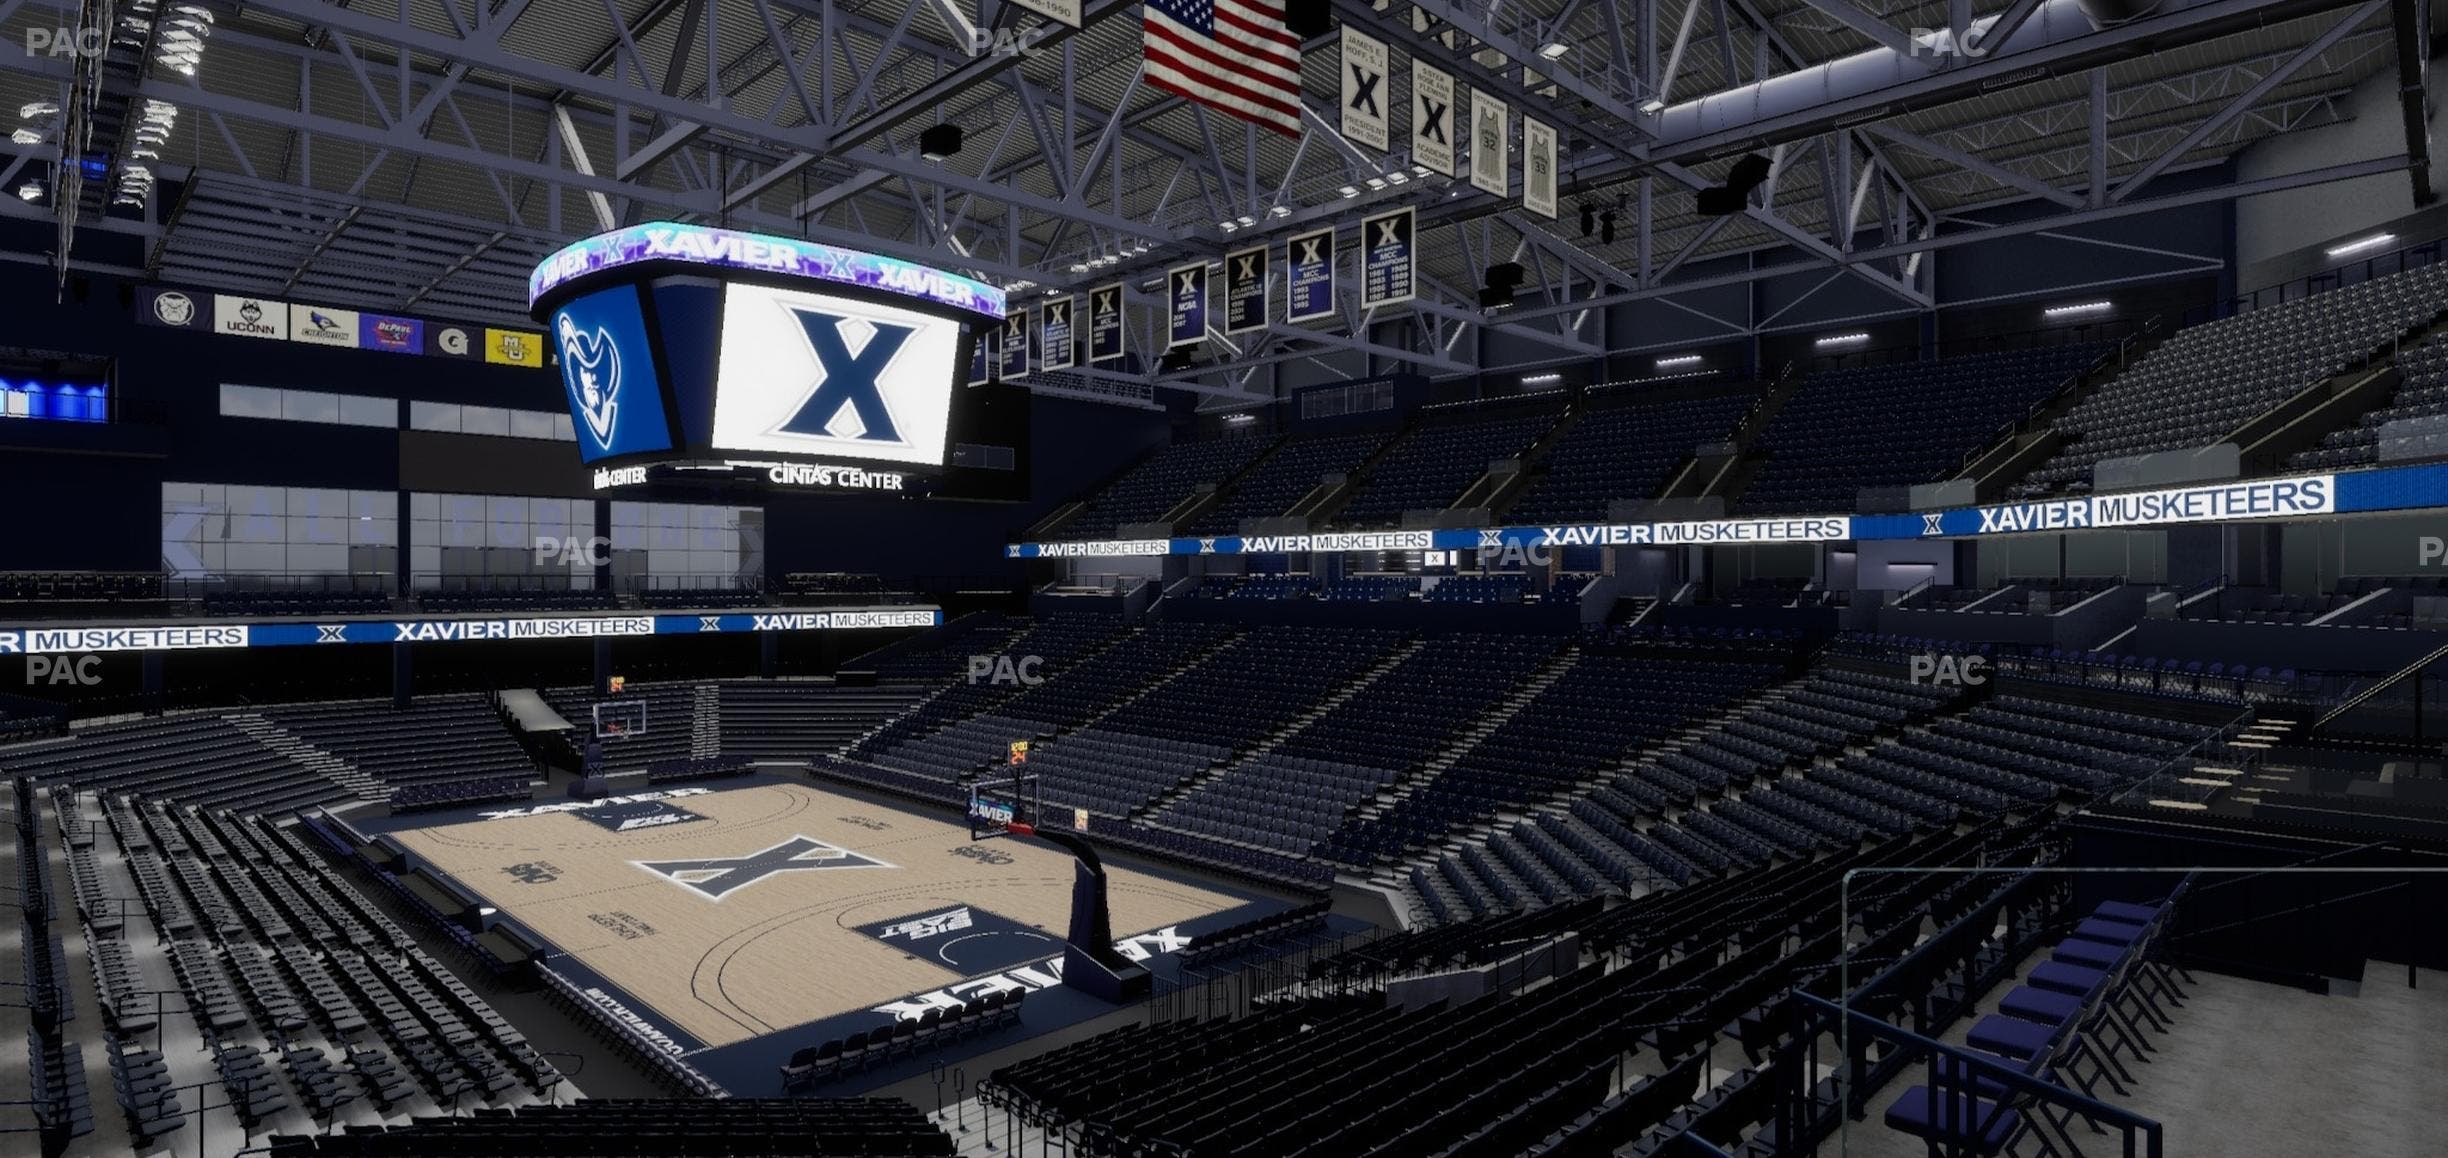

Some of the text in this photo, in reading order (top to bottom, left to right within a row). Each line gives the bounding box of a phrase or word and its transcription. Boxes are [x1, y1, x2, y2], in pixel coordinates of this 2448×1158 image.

[1350, 62, 1382, 120] X
[1420, 94, 1448, 146] X
[1482, 136, 1496, 151] 32
[1534, 161, 1546, 175] 33
[1374, 218, 1400, 247] X
[1301, 238, 1322, 265] X
[1367, 255, 1409, 270] CHAMPIONS
[1380, 250, 1398, 261] MCC
[603, 235, 625, 265] X
[644, 229, 802, 271] XAVIER
[826, 250, 856, 280] X
[877, 262, 976, 306] XAVIER
[1237, 255, 1256, 280] X
[1179, 270, 1198, 296] X
[1050, 303, 1065, 326] X
[1098, 291, 1114, 314] X
[226, 320, 275, 335] UCONN
[1007, 315, 1021, 337] X
[438, 327, 469, 356] G
[765, 300, 925, 446] X
[838, 468, 903, 491] CENTER
[1038, 543, 1087, 558] XAVIER
[1089, 541, 1167, 556] MUSKETEERS
[1241, 535, 1311, 553] XAVIER
[1316, 532, 1430, 549] MUSKETEERS
[1542, 524, 1652, 546] XAVIER
[1660, 518, 1844, 543] MUSKETEERS
[1922, 513, 1944, 536] X
[1978, 499, 2093, 534] XAVIER
[2098, 479, 2326, 523] MUSKETEERS
[35, 627, 243, 651] MUSKETEERS
[394, 620, 507, 642] XAVIER
[514, 618, 651, 637] MUSKETEERS
[752, 614, 831, 631] XAVIER
[835, 611, 932, 627] MUSKETEERS
[1011, 751, 1026, 765] 24
[968, 801, 1014, 824] XAVIER
[624, 834, 901, 903] X
